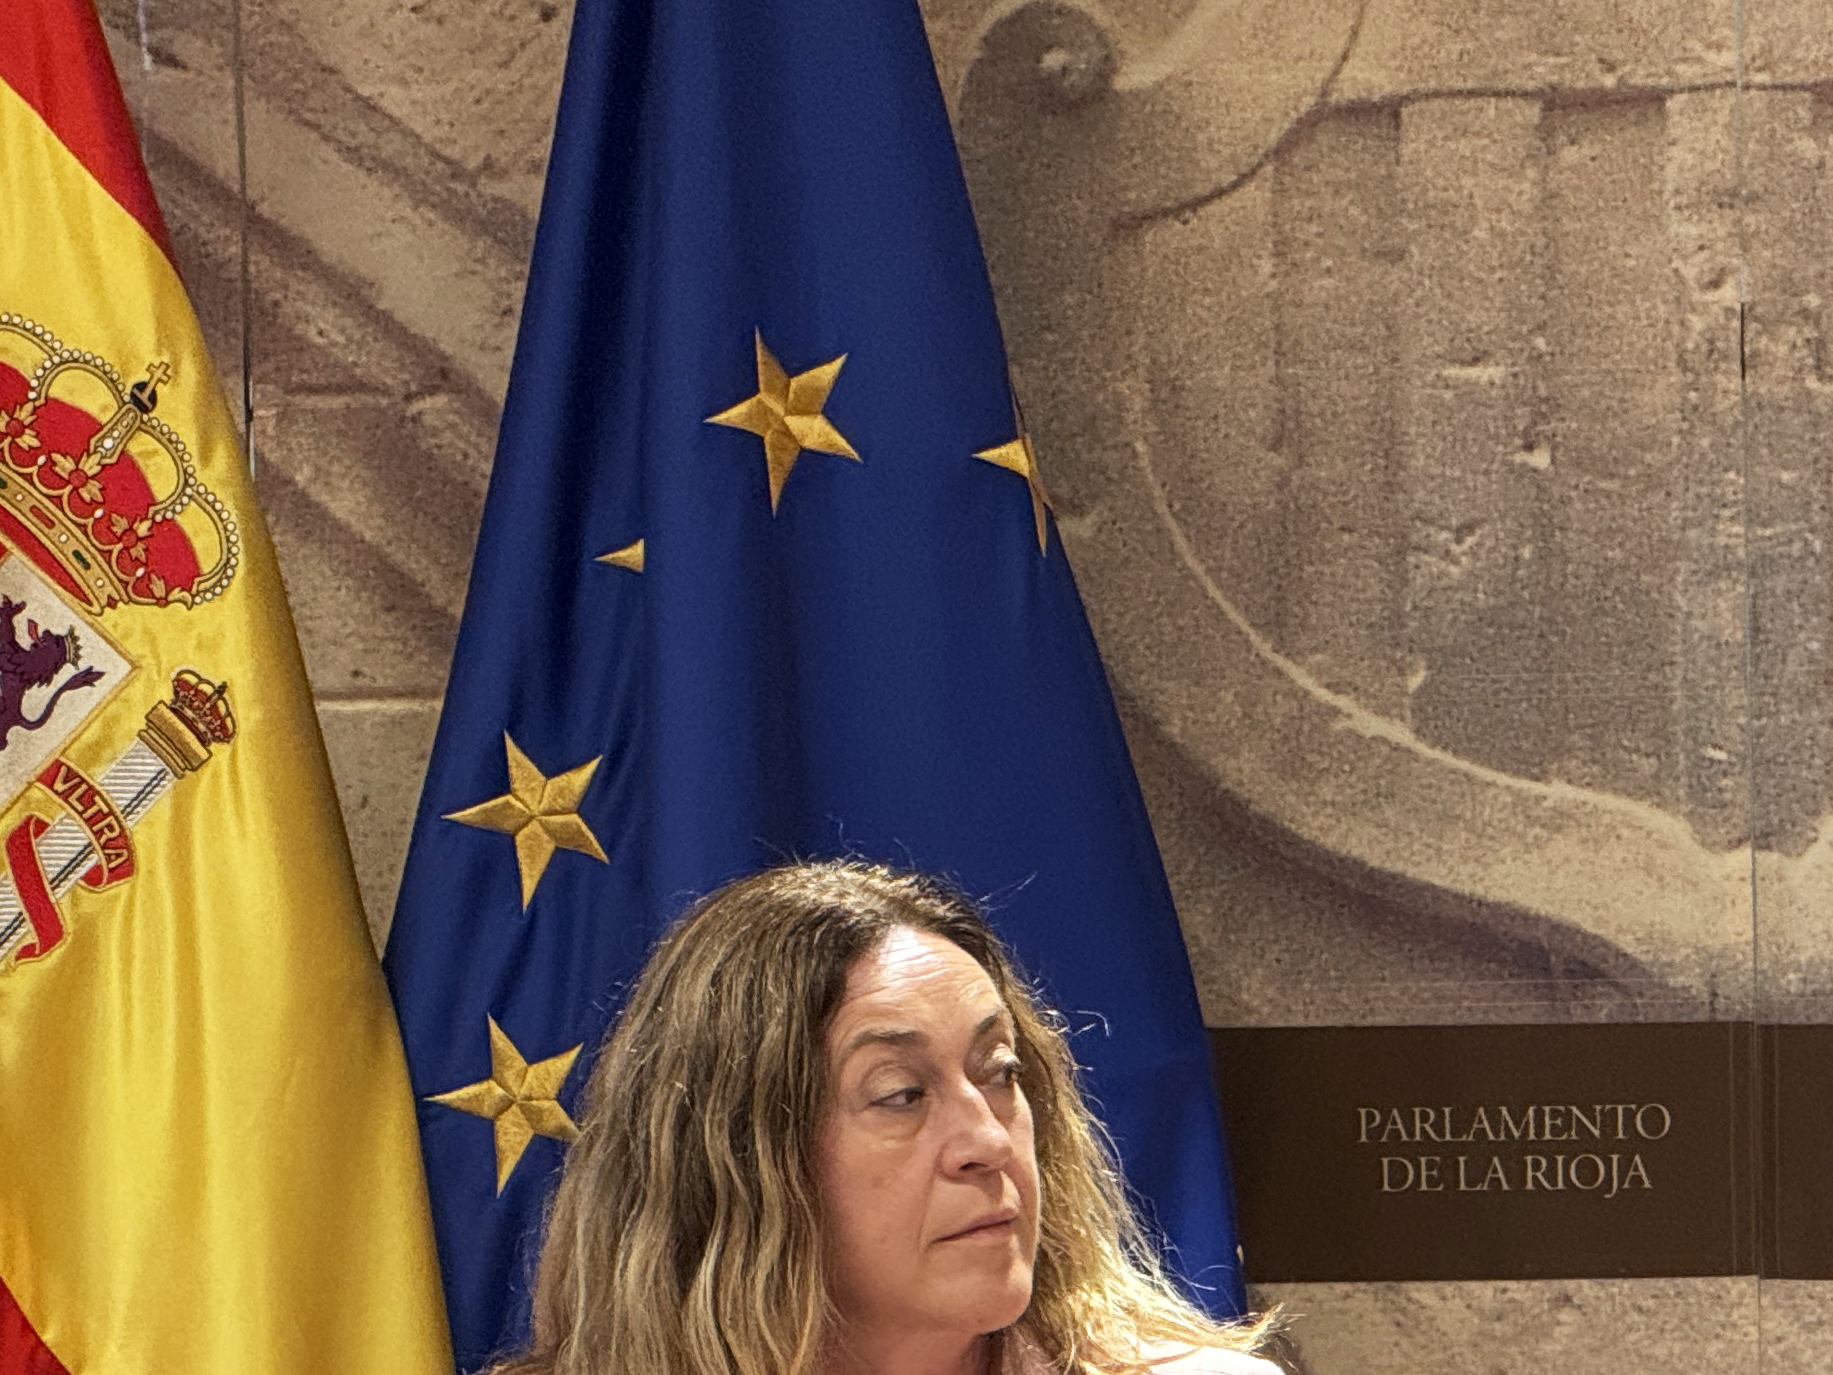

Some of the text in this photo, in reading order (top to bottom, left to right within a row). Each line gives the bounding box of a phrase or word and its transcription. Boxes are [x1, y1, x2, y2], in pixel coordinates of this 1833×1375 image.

[51, 765, 129, 869] VLTRA
[1357, 1103, 1672, 1142] PARLAMENTO
[1380, 1153, 1654, 1199] DE LA RIOJA
